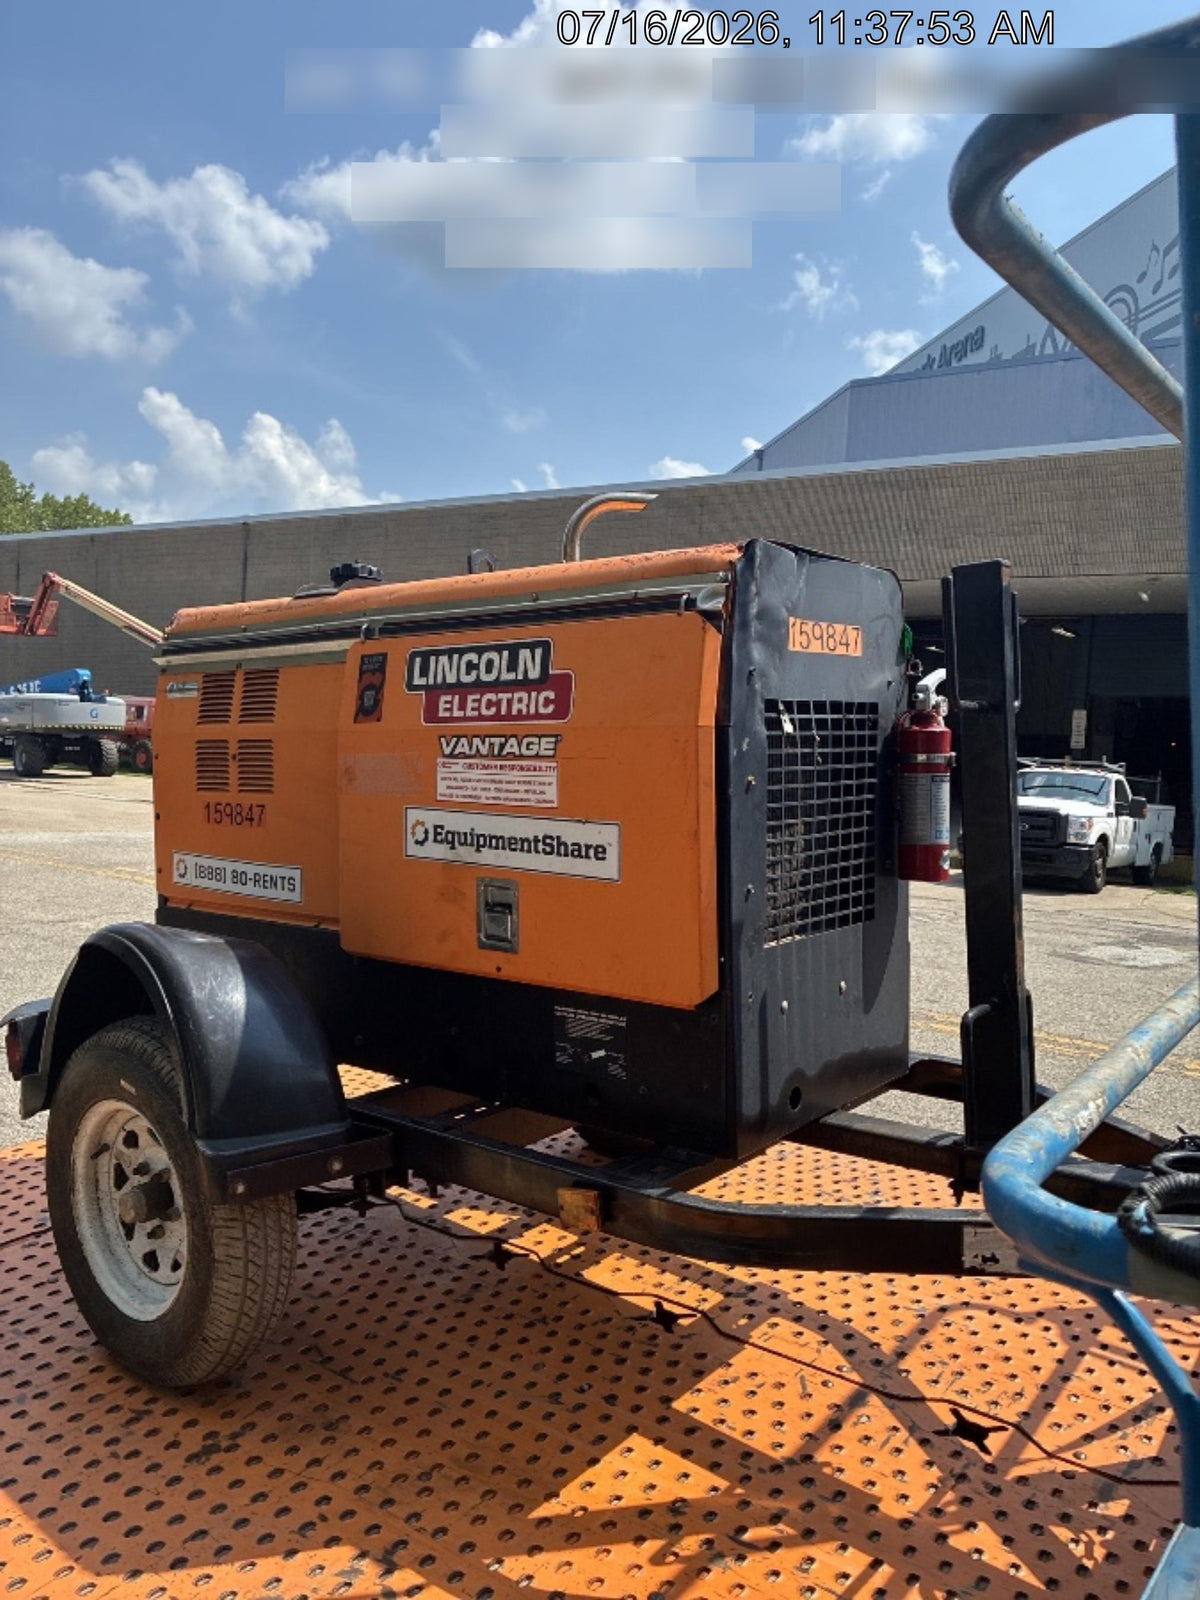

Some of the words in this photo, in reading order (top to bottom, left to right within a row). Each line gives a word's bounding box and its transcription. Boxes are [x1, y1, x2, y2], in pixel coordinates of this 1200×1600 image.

[937, 325, 985, 367] Arena
[789, 621, 860, 653] 159847
[412, 647, 543, 686] LINCOLN
[438, 690, 556, 718] ELECTRIC
[440, 736, 558, 757] VANTAGE
[204, 801, 266, 827] 159847
[433, 824, 608, 861] EquipmentShare
[231, 869, 296, 893] 80-RENTS
